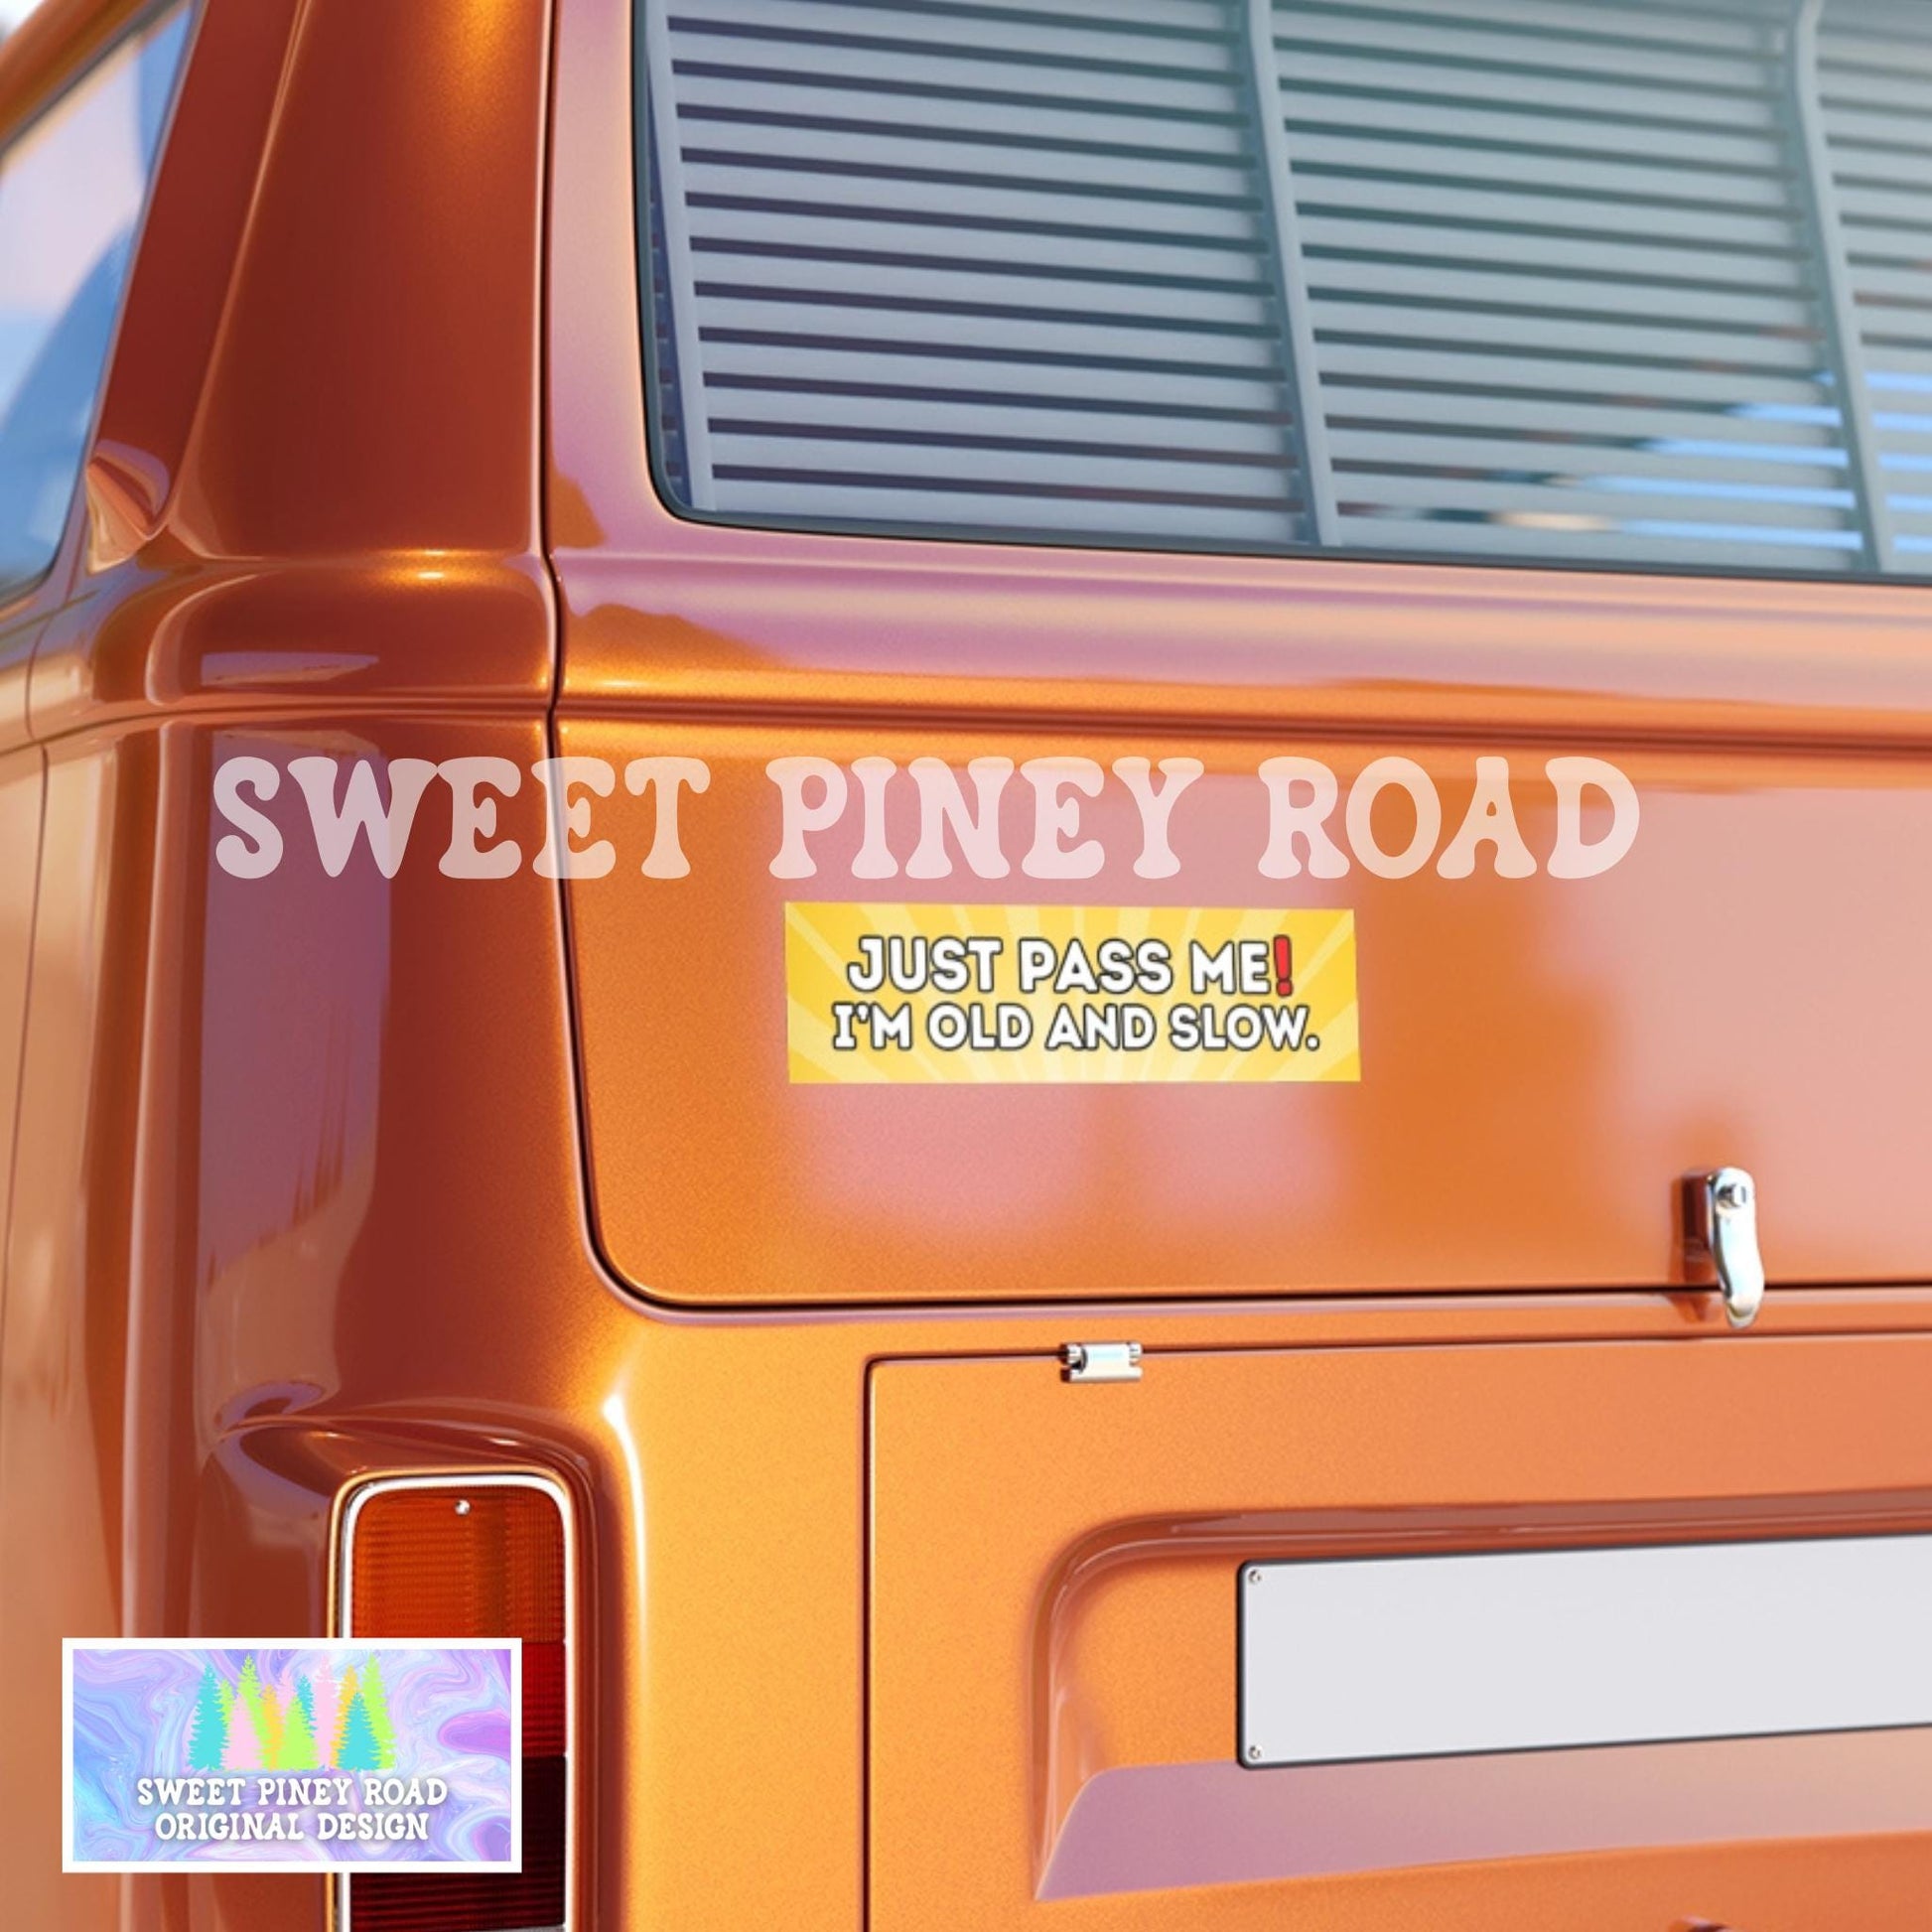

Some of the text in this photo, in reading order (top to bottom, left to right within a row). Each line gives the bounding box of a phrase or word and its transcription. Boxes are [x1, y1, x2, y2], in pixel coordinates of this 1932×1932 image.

[847, 933, 1295, 997] JUST PASS ME!
[832, 1002, 1320, 1051] I'M OLD AND SLOW.
